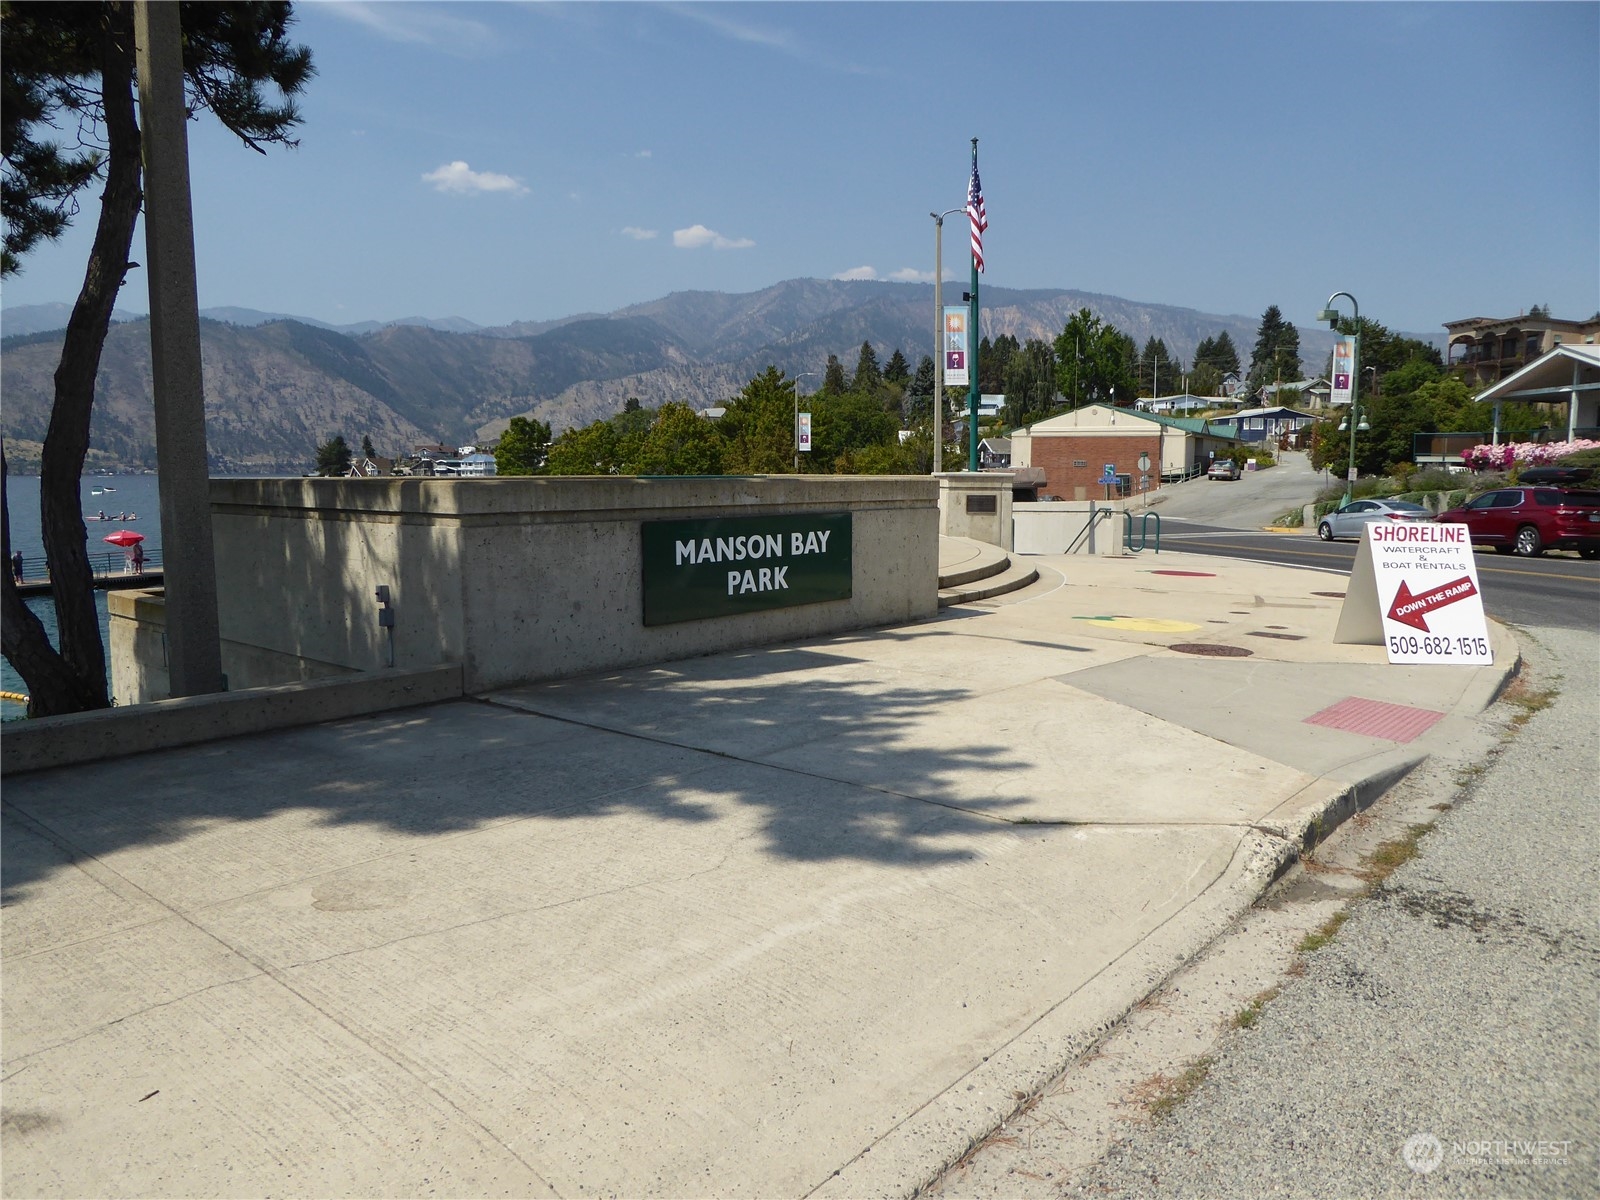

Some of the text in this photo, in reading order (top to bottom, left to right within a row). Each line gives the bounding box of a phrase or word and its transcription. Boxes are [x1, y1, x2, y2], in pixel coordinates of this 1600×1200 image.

[1373, 526, 1466, 543] SHORELINE
[675, 530, 831, 566] MANSON BAY
[1383, 546, 1461, 554] WATERCRAFT
[1382, 561, 1467, 570] BOAT RENTALS
[1418, 554, 1428, 562] &
[727, 565, 789, 596] PARK
[1395, 581, 1472, 617] DOWN THE RAMP
[1389, 636, 1488, 656] 509-682-1515
